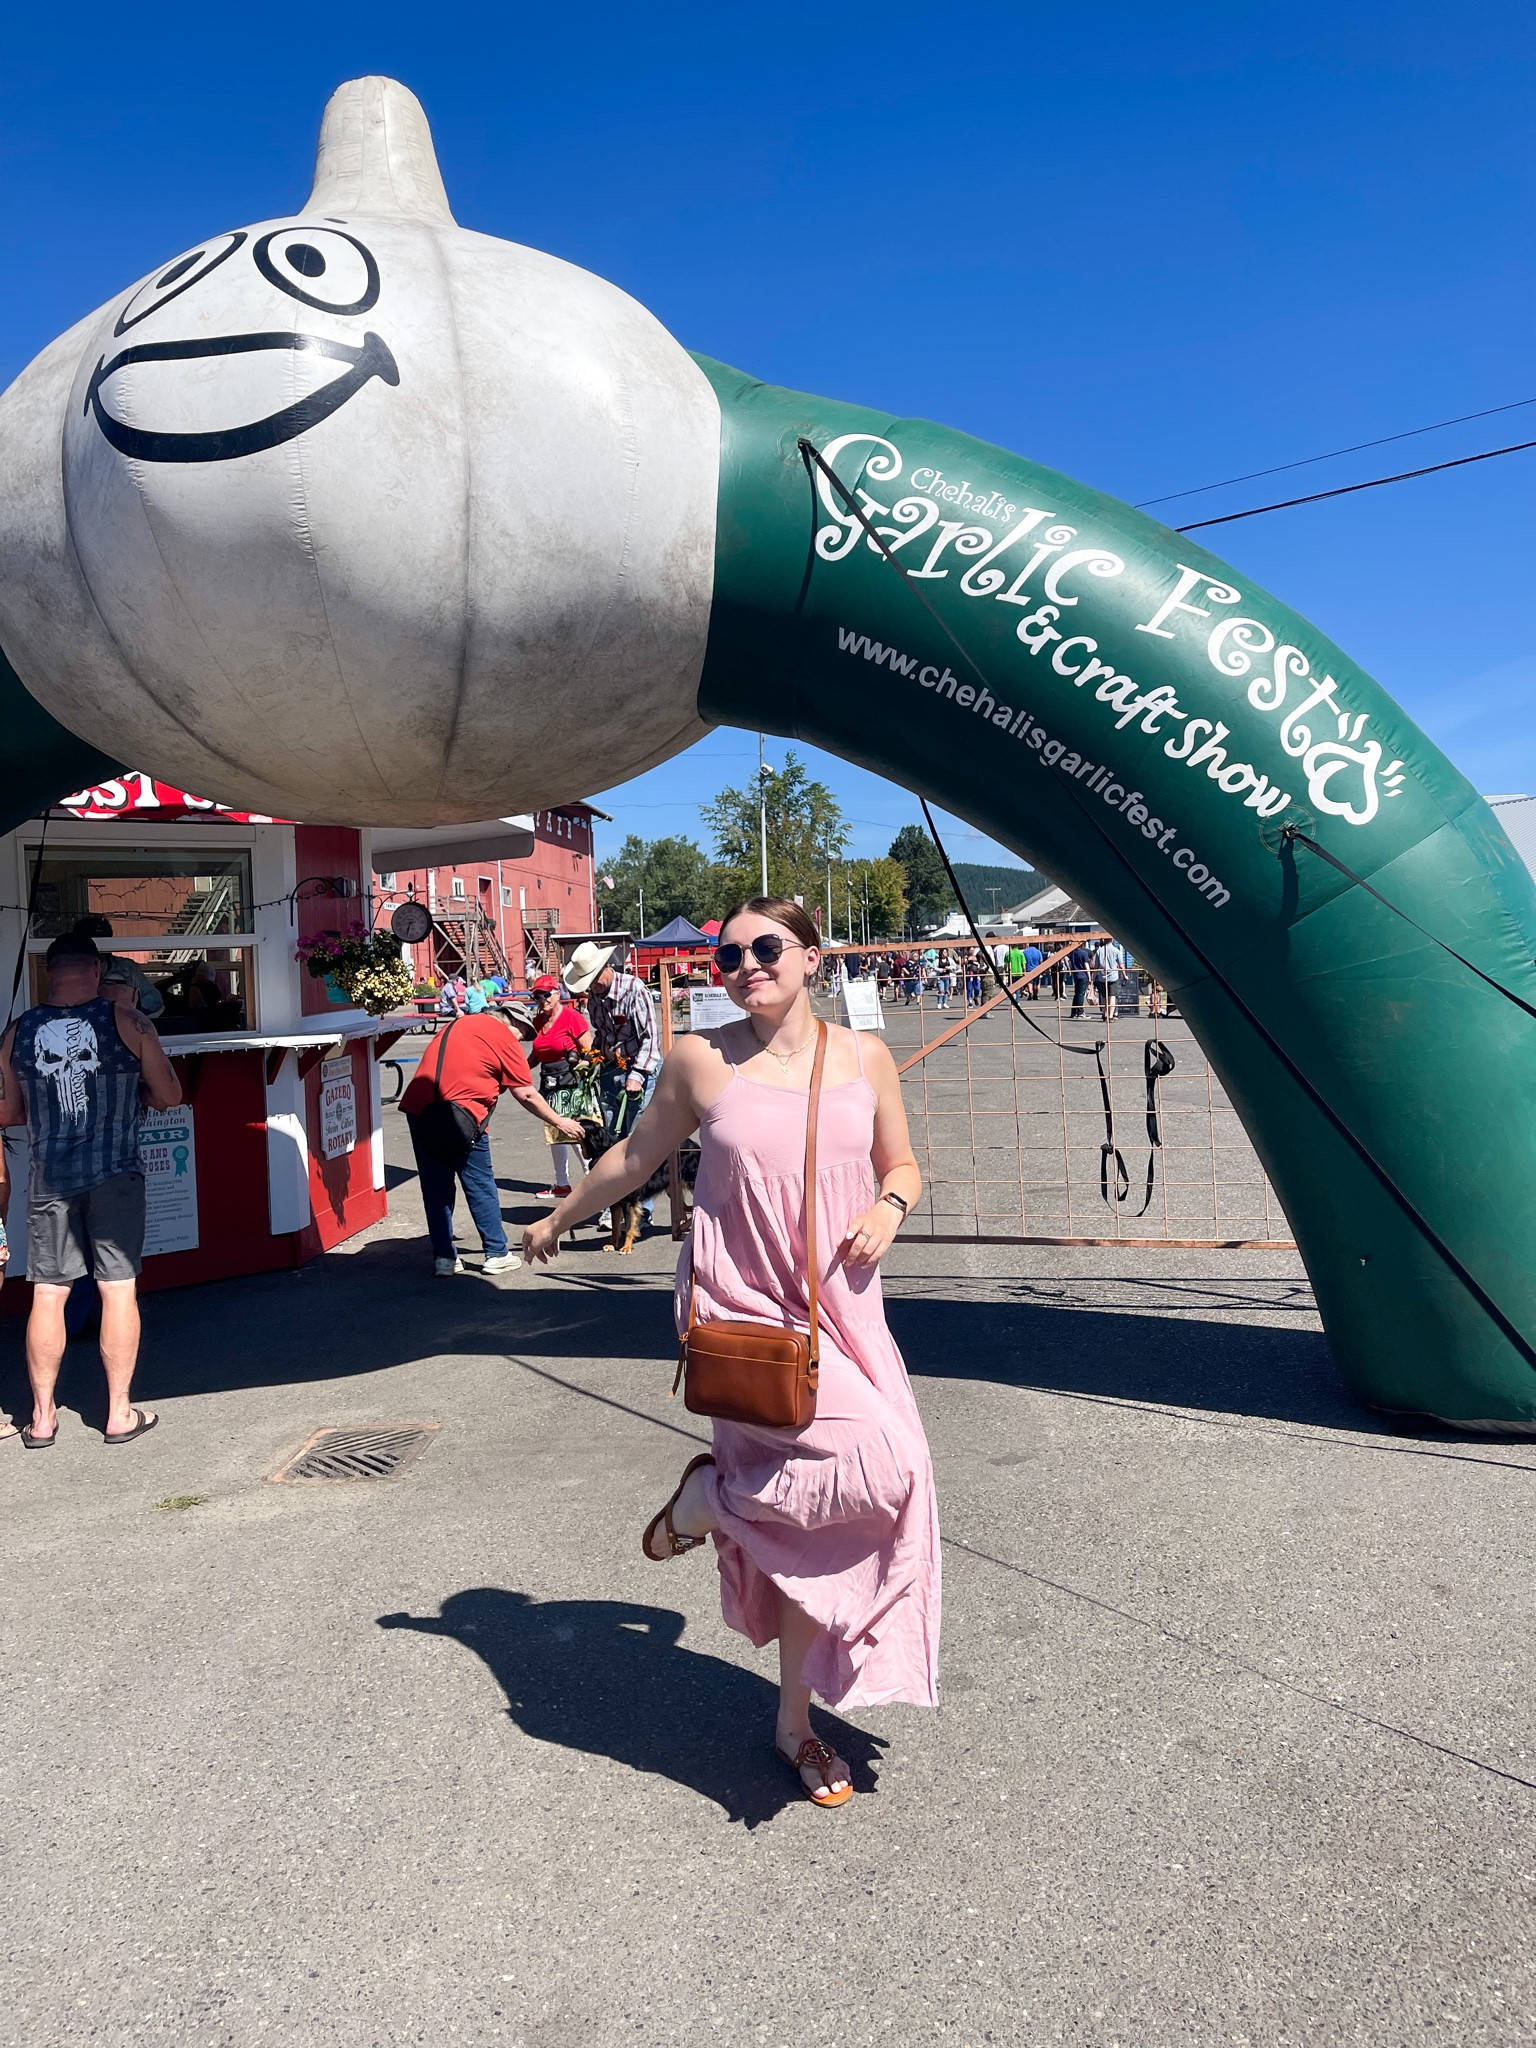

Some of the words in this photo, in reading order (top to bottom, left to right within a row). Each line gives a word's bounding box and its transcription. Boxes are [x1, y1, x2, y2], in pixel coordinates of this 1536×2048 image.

[910, 467, 1016, 522] Chehalis
[814, 433, 1125, 606] Garlic
[1136, 562, 1341, 757] Fest
[1016, 604, 1062, 656] &
[1052, 636, 1188, 734] Craft
[837, 627, 1232, 909] www.chehalisgarlicfest.com
[59, 771, 161, 809] ST
[326, 1084, 351, 1106] GAZEBO
[145, 1117, 186, 1127] hington
[148, 1107, 182, 1118] thwest
[140, 1129, 184, 1142] AIR
[328, 1131, 353, 1152] ROTARY
[150, 1147, 168, 1160] AND
[143, 1160, 171, 1173] POSES
